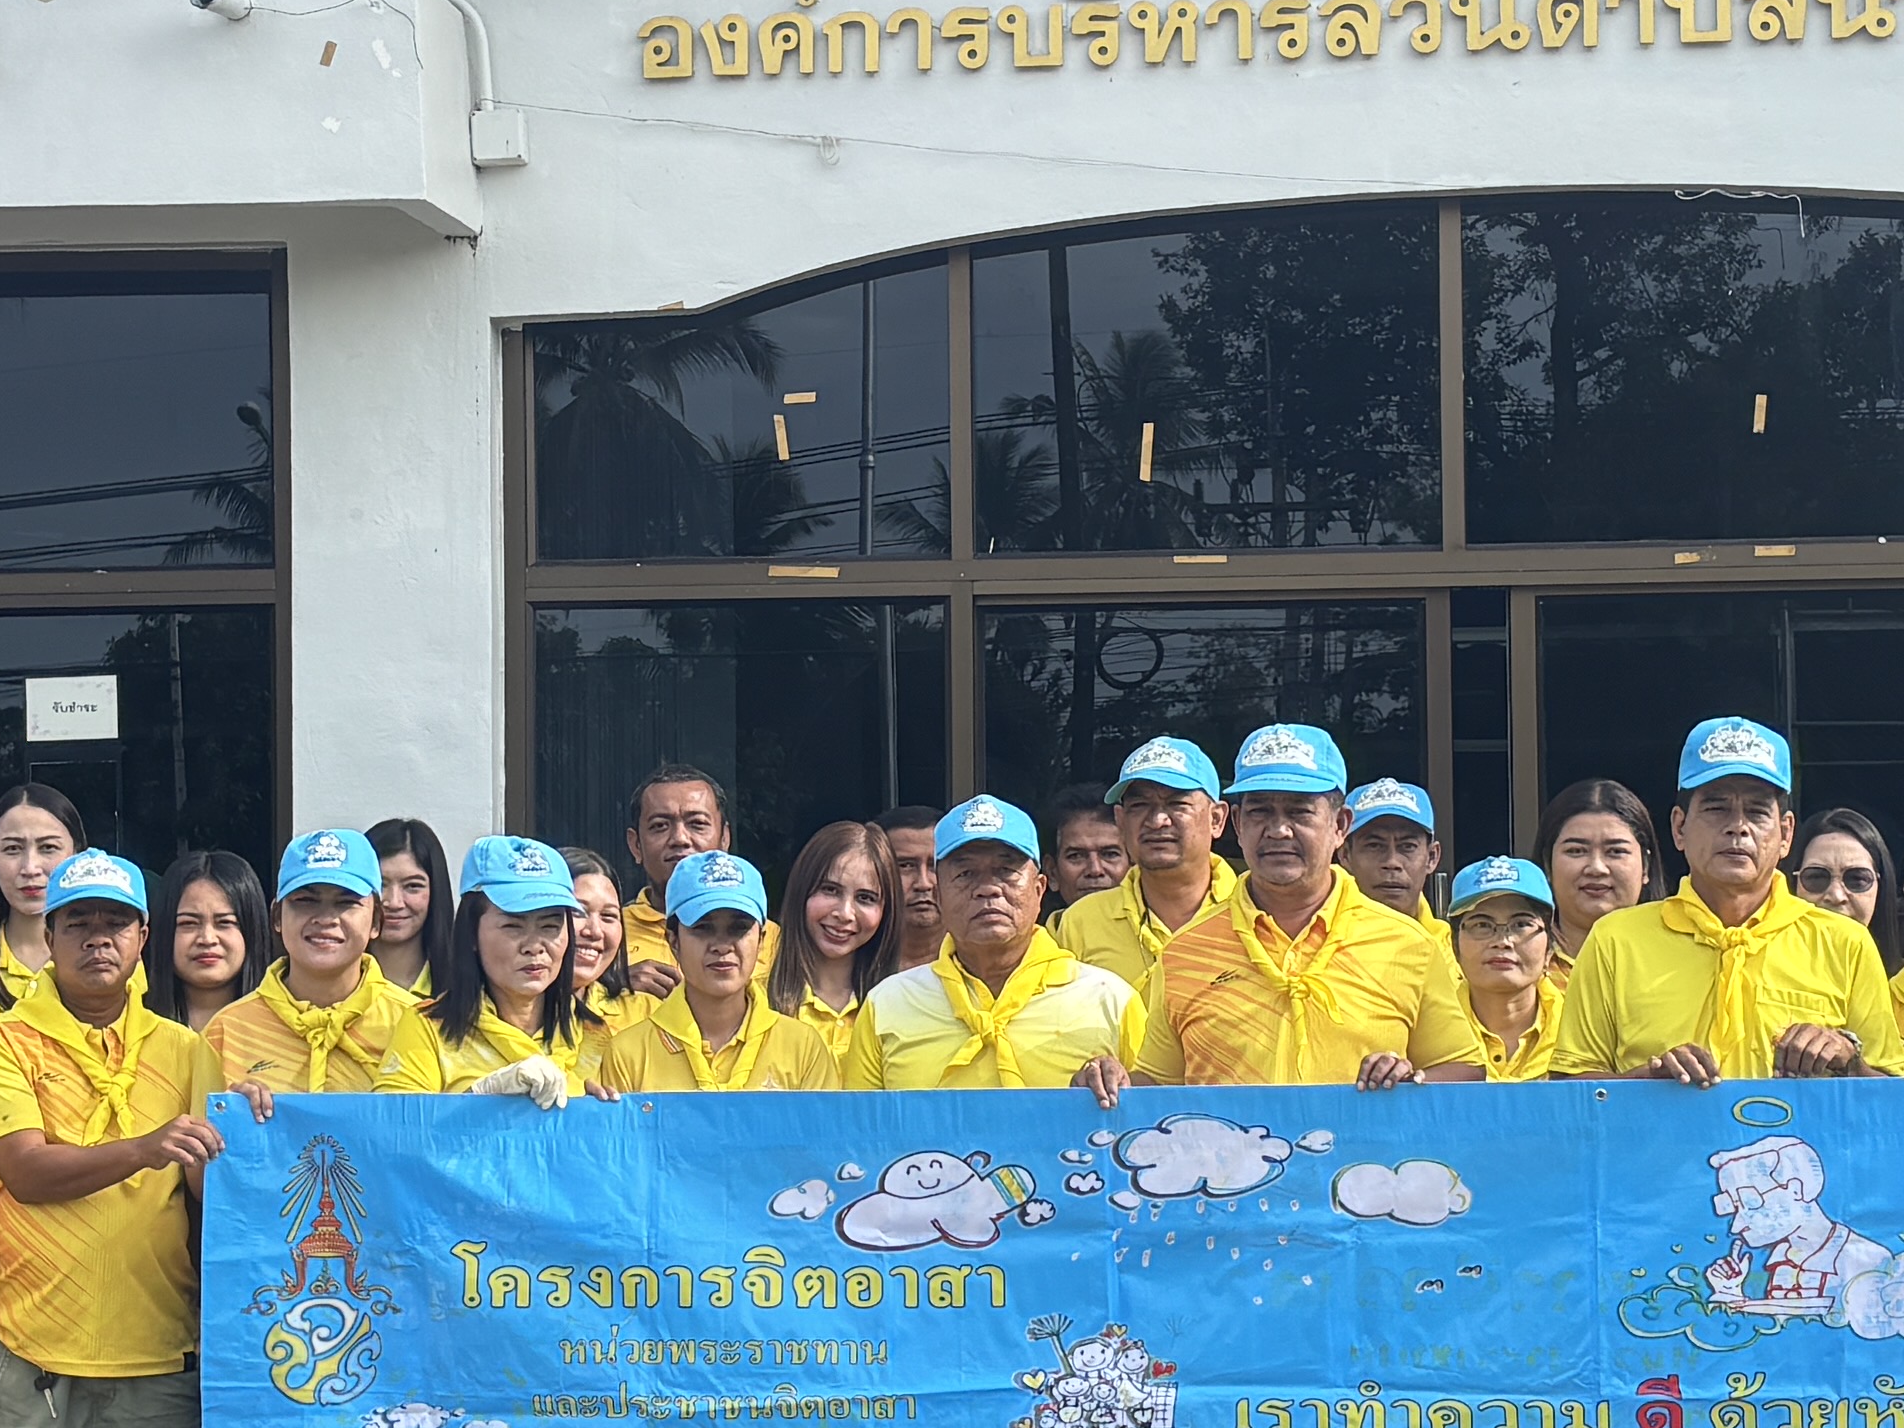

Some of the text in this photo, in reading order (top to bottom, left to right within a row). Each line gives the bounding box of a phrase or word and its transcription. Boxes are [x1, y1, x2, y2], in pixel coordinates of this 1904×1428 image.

[451, 1238, 1007, 1312] โครงการจิตอาสา
[558, 1324, 889, 1366] หน่วยพระราชทาน
[532, 1380, 917, 1420] และประชาชนจิตอาสา
